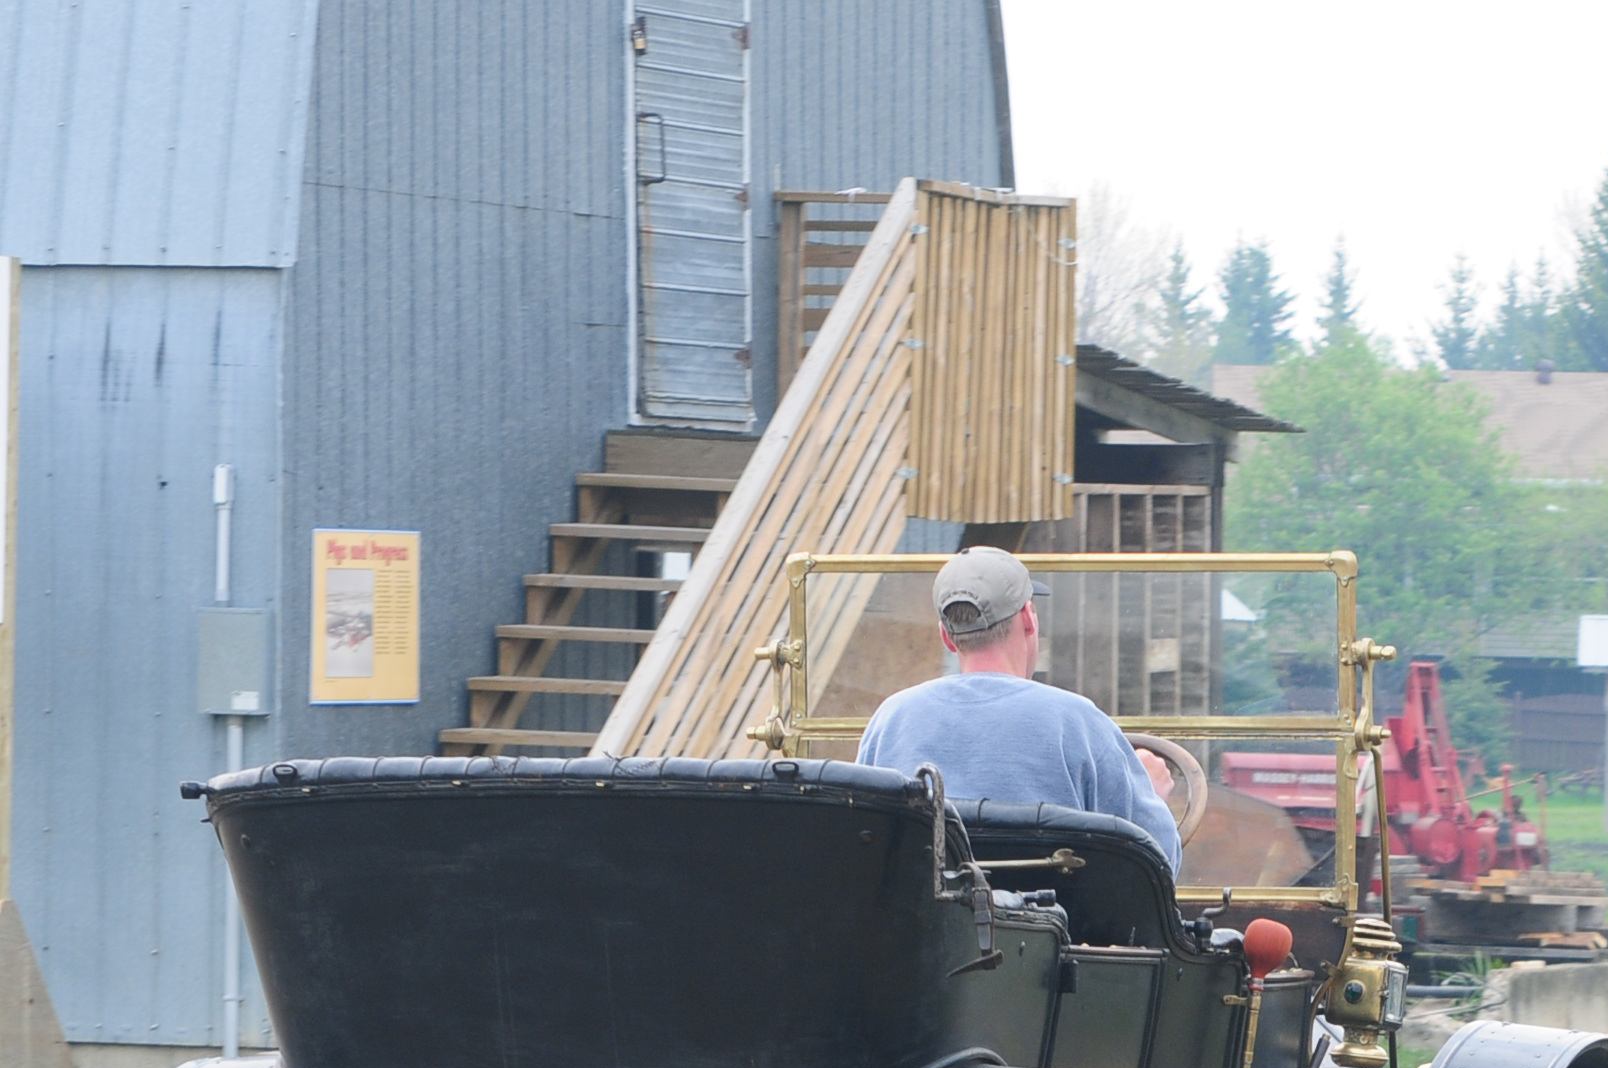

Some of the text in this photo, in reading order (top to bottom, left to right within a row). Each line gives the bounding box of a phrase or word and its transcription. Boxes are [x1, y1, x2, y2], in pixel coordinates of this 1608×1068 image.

[327, 539, 408, 566] Pigs and Progress
